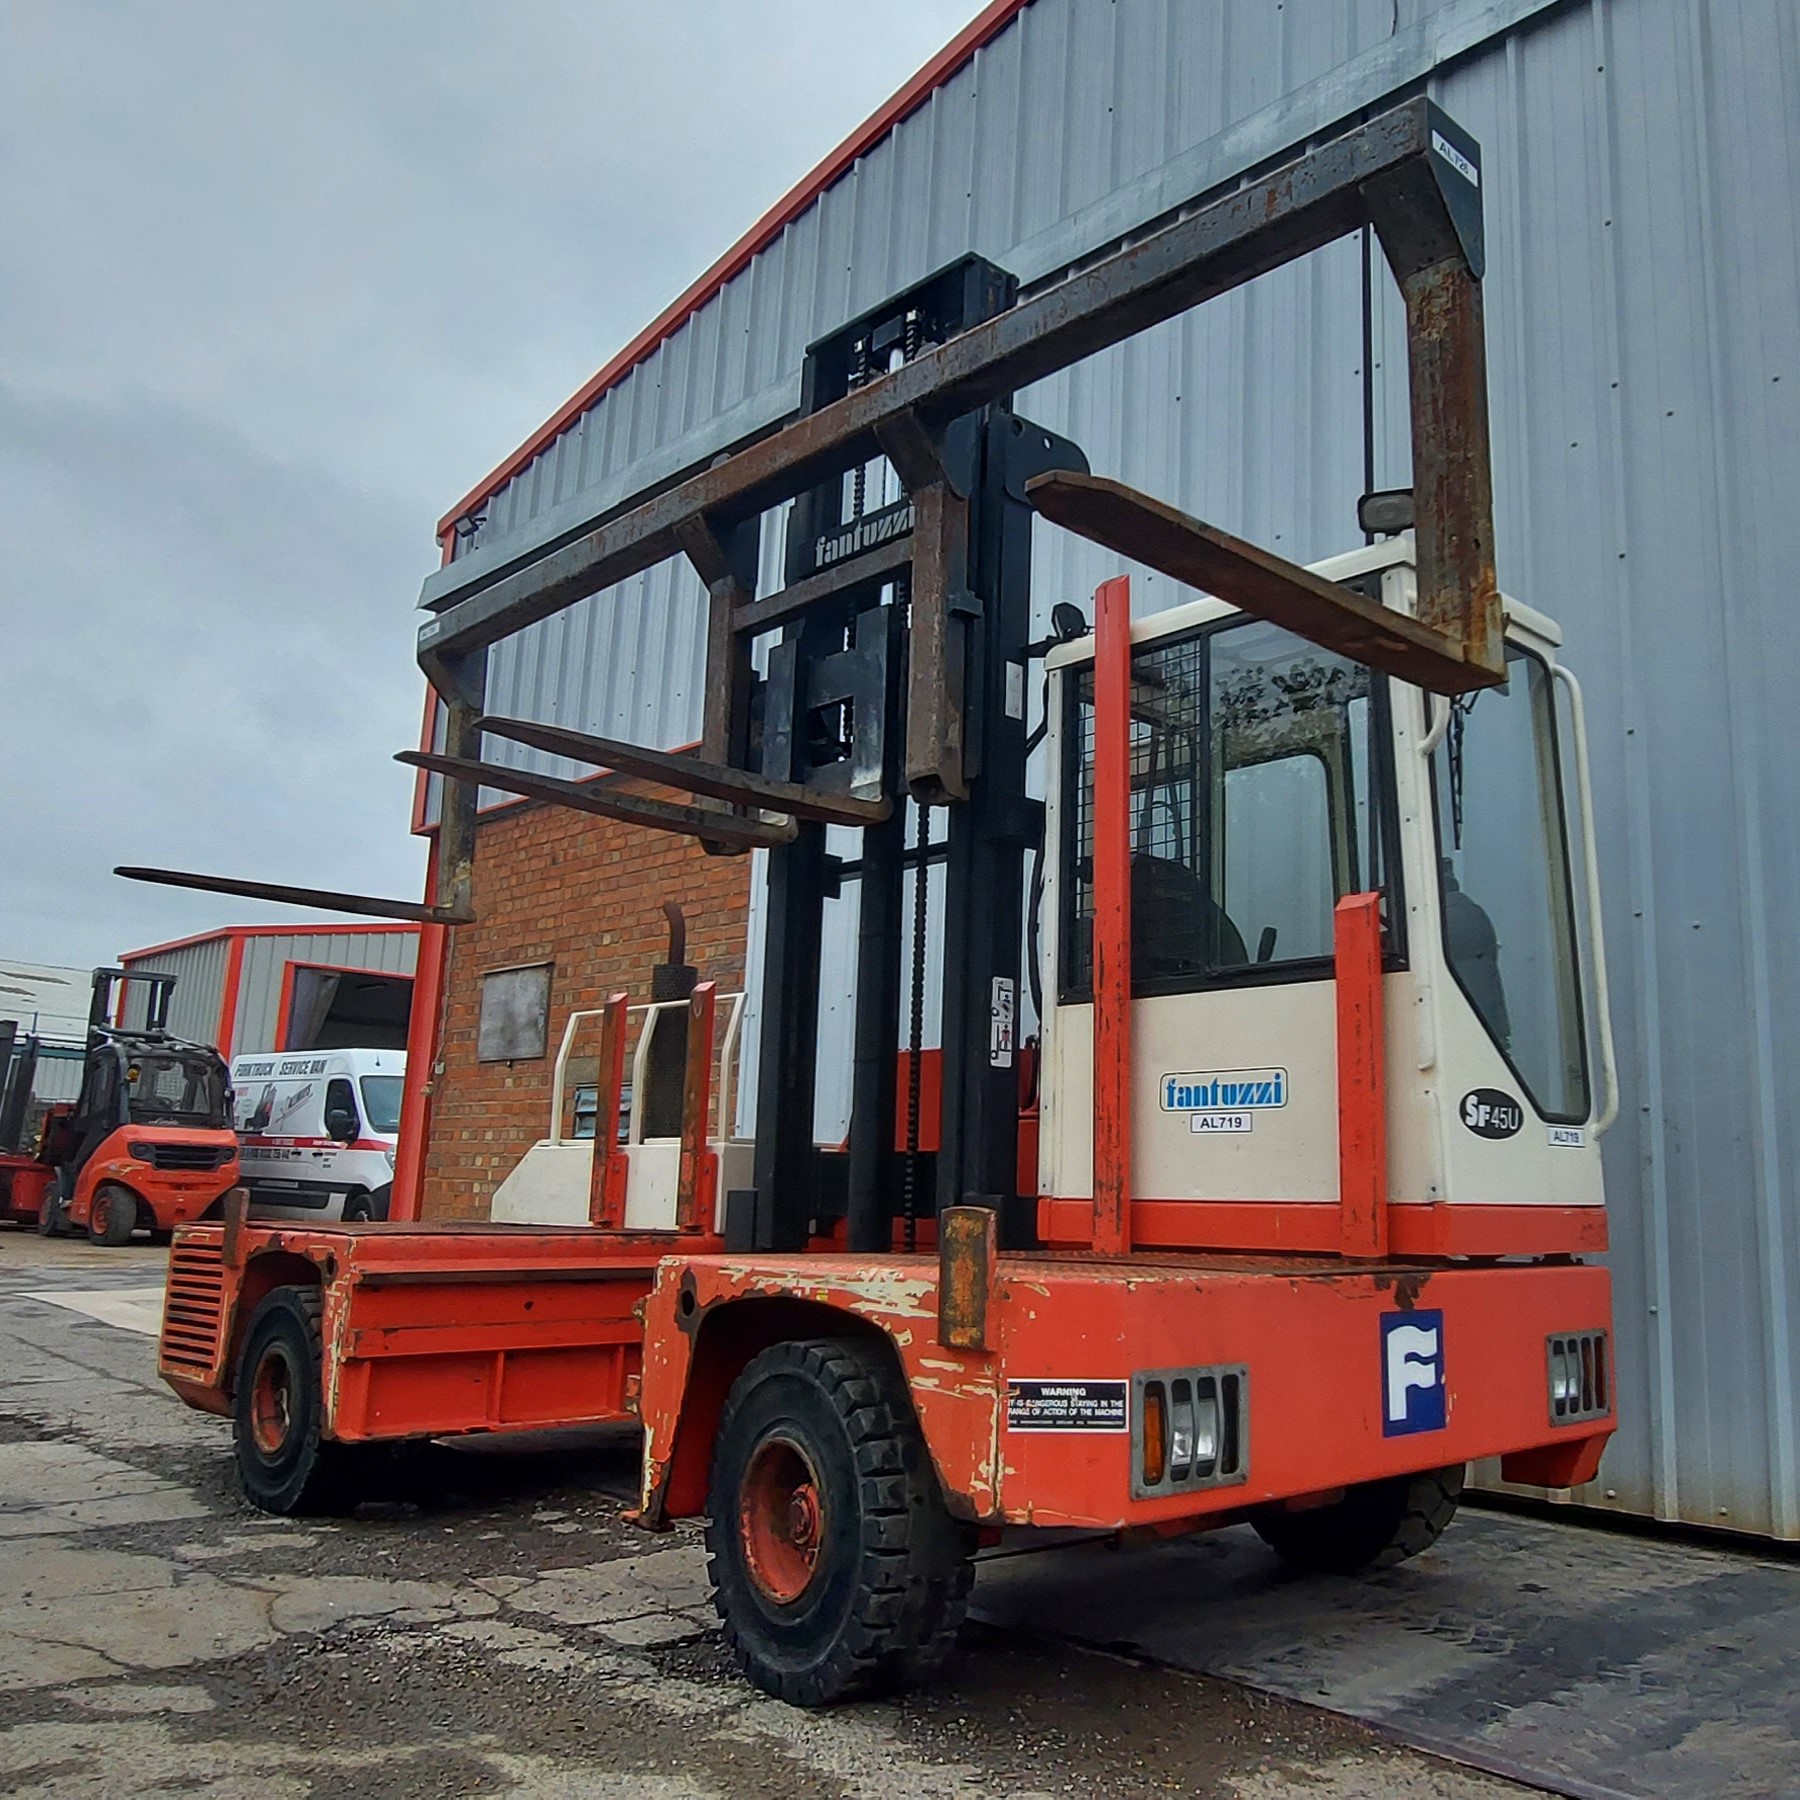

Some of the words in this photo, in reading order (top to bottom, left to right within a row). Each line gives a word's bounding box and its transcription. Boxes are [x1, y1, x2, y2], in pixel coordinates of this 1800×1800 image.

[279, 1060, 312, 1075] SERVICE
[1166, 1072, 1282, 1108] fantuzzi
[1200, 1117, 1243, 1129] AL719
[1553, 1131, 1580, 1143] AL719
[1040, 1387, 1087, 1397] WARNING
[1100, 1399, 1109, 1408] IN
[1111, 1399, 1124, 1408] THE
[1031, 1408, 1041, 1416] OF
[1042, 1408, 1067, 1416] ACTION
[1068, 1408, 1078, 1417] OF
[1080, 1408, 1092, 1416] THE
[1094, 1408, 1124, 1417] MACHINE
